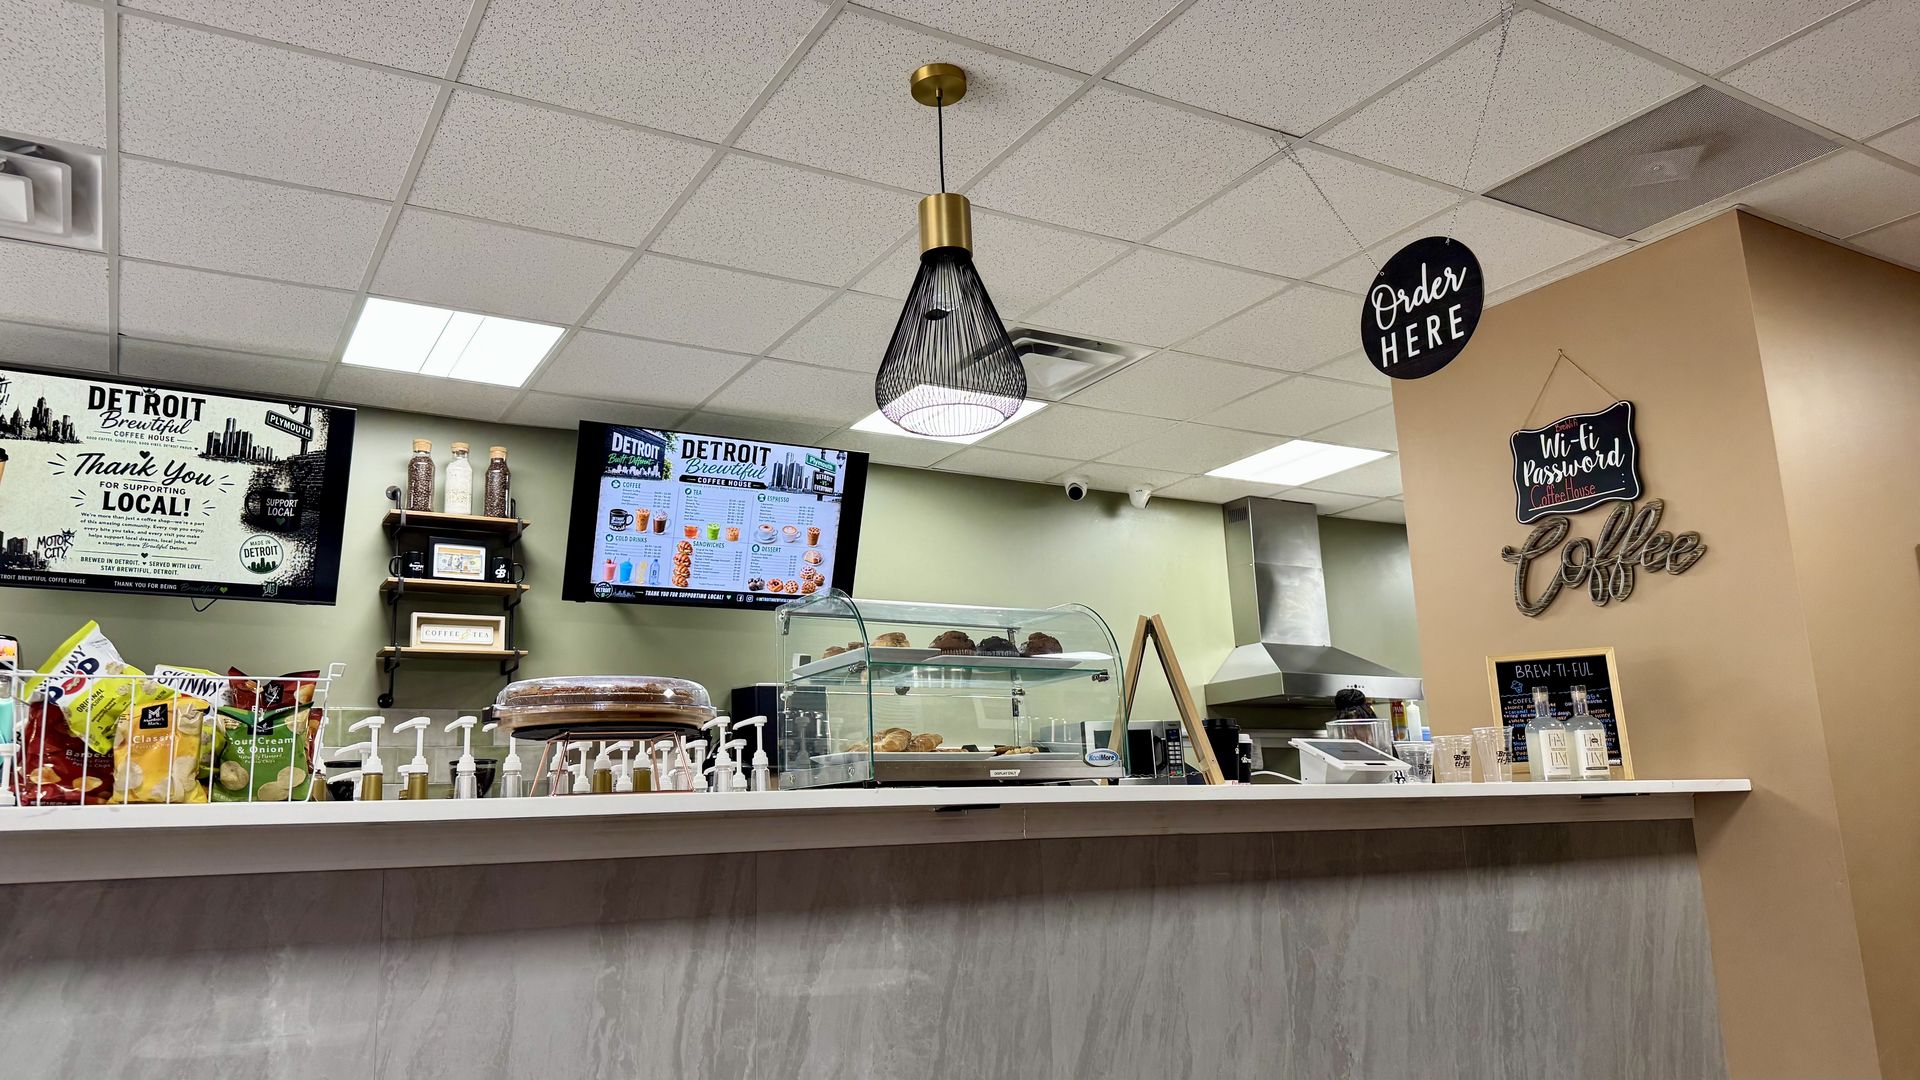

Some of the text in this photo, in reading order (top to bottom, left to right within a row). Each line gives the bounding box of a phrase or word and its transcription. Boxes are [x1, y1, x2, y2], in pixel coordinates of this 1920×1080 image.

[1371, 262, 1466, 330] Order
[1380, 303, 1465, 367] HERE
[88, 385, 206, 422] DETROIT
[100, 410, 192, 435] Brewtiful
[270, 415, 311, 438] PLYMOUTH
[114, 430, 175, 442] COFFEE HOUSE
[611, 432, 660, 460] DETROIT
[1540, 423, 1600, 458] Wi-Fi
[681, 439, 771, 466] DETROIT
[1524, 438, 1625, 486] Password
[73, 452, 215, 486] Thank You
[685, 458, 767, 480] Brewtiful
[816, 474, 833, 482] DETROIT
[100, 481, 186, 495] FOR SUPPORTING
[102, 490, 191, 517] LOCAL!
[266, 498, 298, 508] SUPPORT
[268, 508, 295, 517] LOCAL
[37, 535, 74, 549] MOTOR
[45, 546, 69, 559] CITY
[244, 545, 278, 558] DETROIT
[1501, 499, 1707, 617] Coffee
[157, 670, 223, 697] SKINNY
